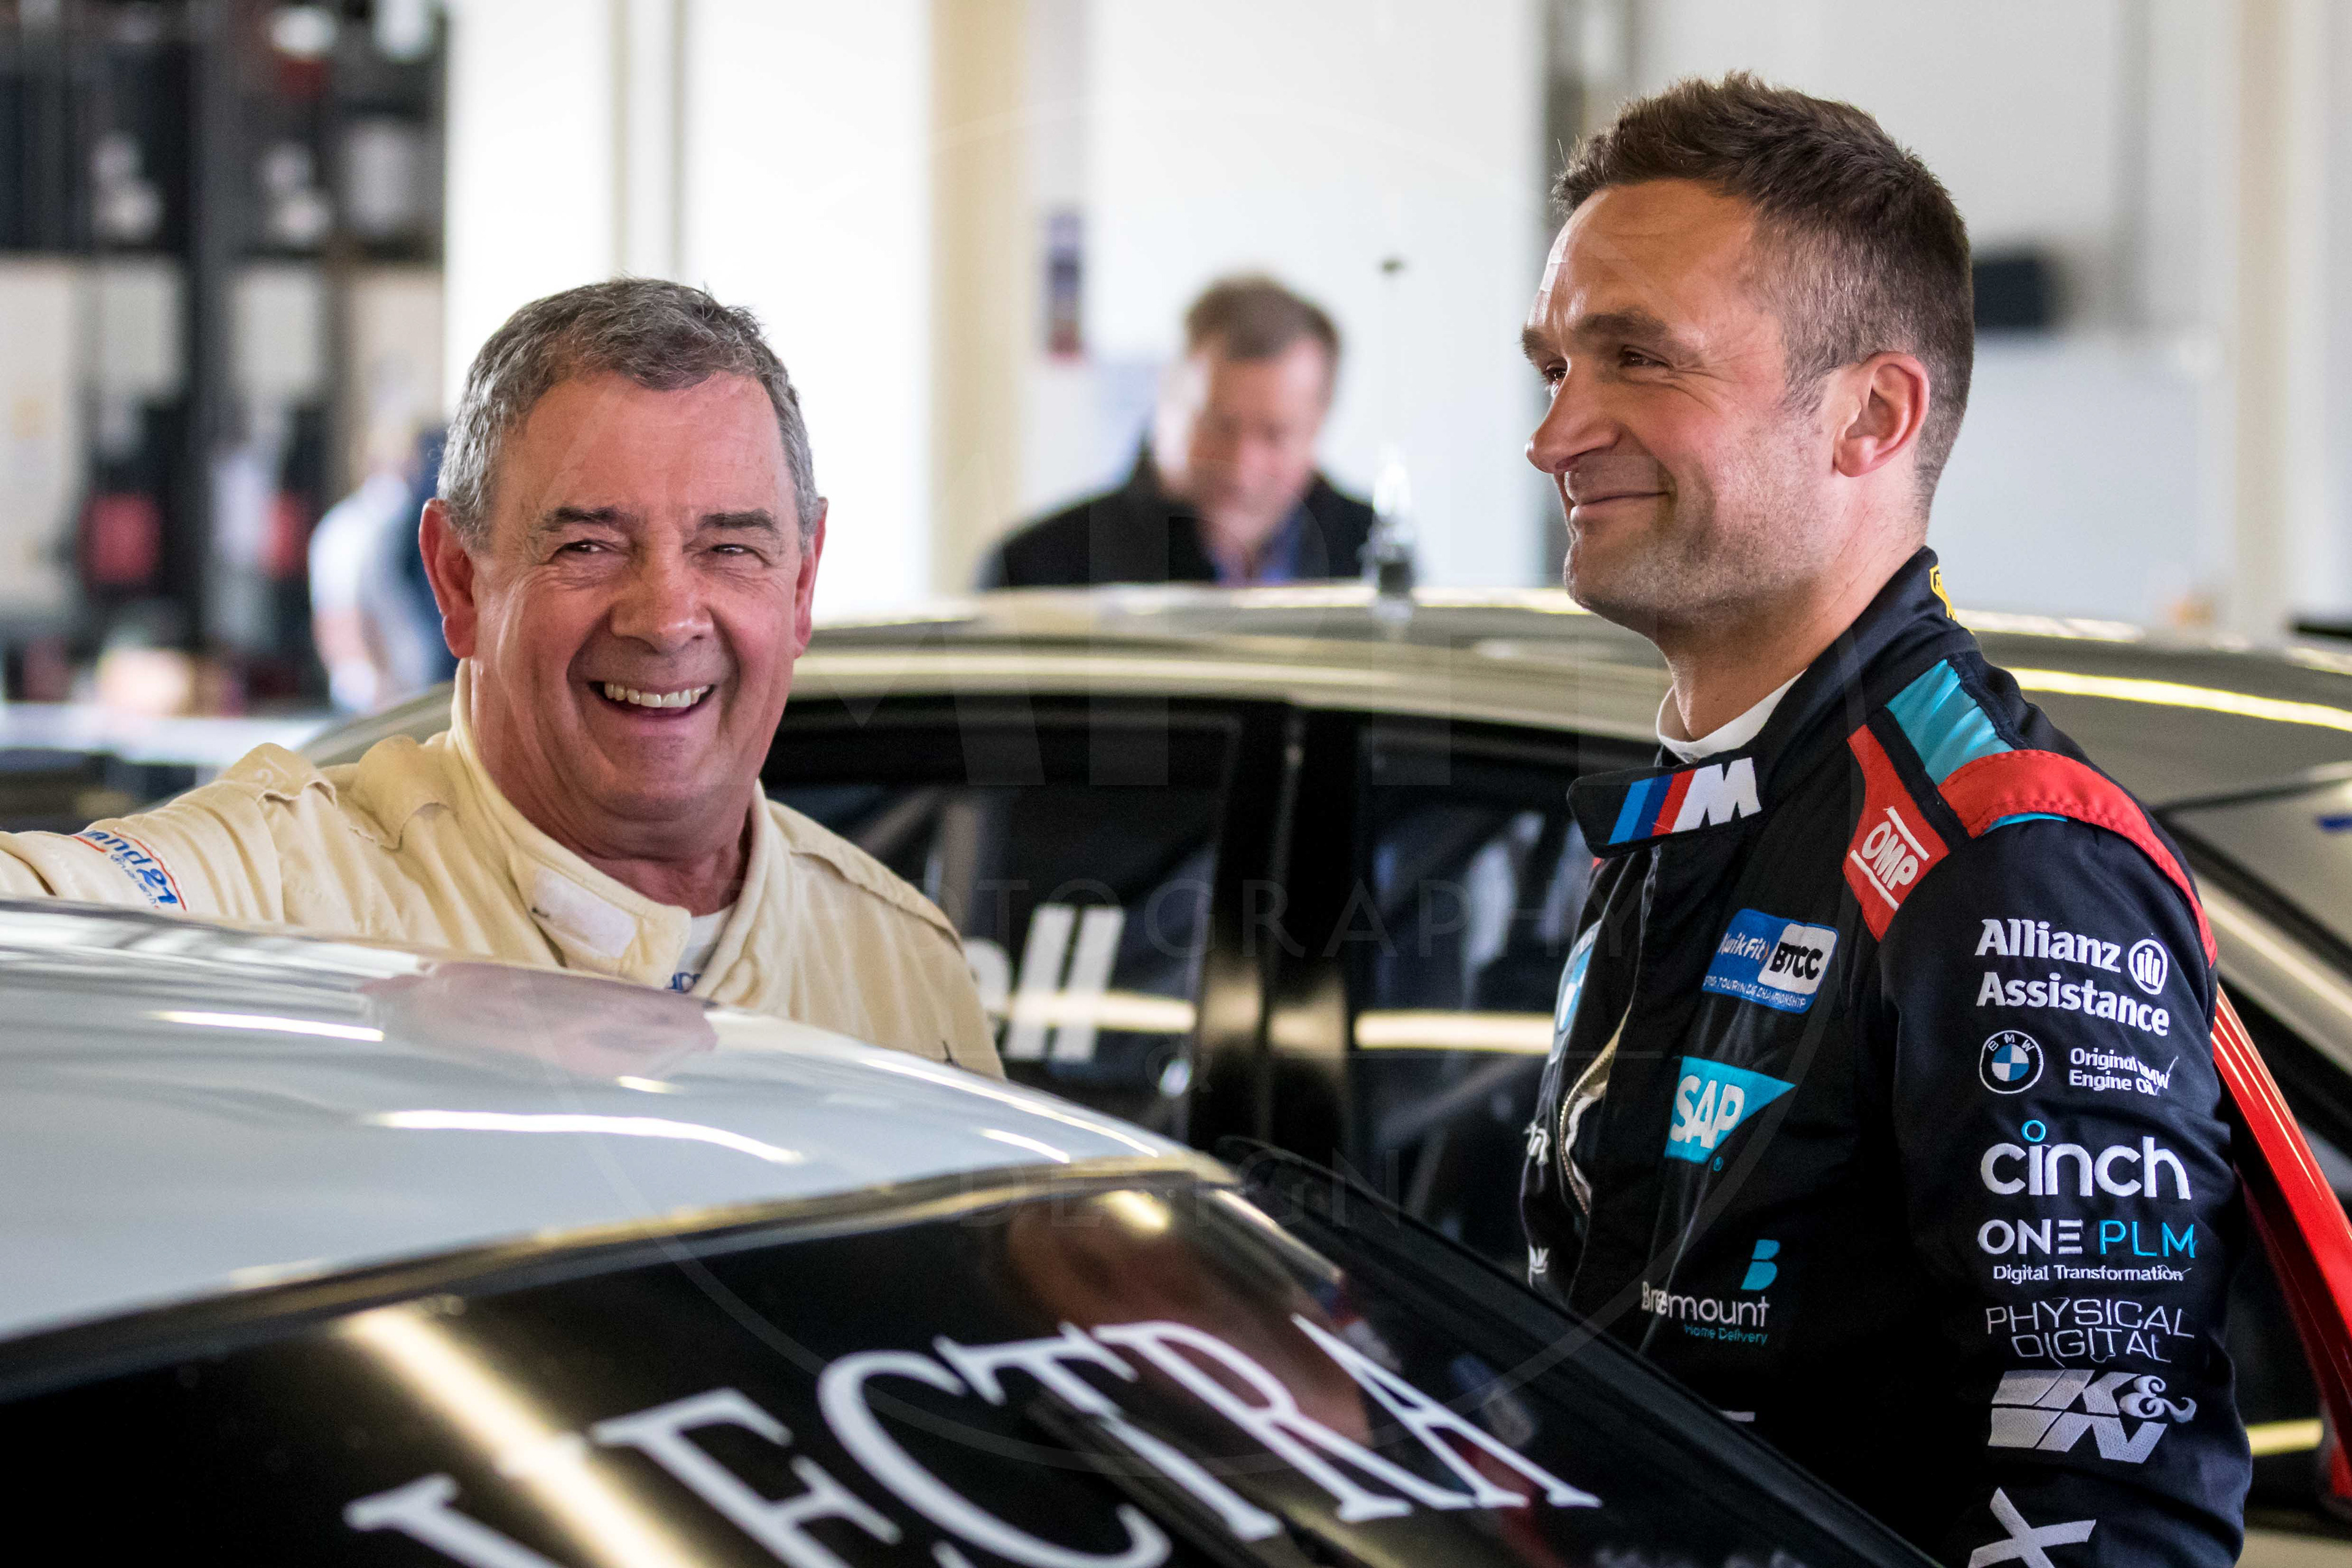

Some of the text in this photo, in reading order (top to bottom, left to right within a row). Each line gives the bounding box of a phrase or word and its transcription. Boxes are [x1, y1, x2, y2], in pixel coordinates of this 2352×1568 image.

[1861, 821, 1919, 891] OMP
[1769, 941, 1823, 980] BTCC
[1975, 919, 2121, 973] Allianz
[1976, 972, 2170, 1036] Assistance
[2070, 1047, 2138, 1072] Original
[2069, 1069, 2158, 1096] Engine Oil
[1670, 1074, 1744, 1148] SAP
[1980, 1120, 2192, 1200] cinch
[1978, 1219, 2198, 1258] ONE PLM
[1993, 1264, 2187, 1284] Digital Transformation
[1642, 1281, 1770, 1327] Bremount
[1986, 1297, 2195, 1339] PHYSICAL
[1717, 1327, 1769, 1345] Delivery
[2011, 1328, 2171, 1366] DIGITAL
